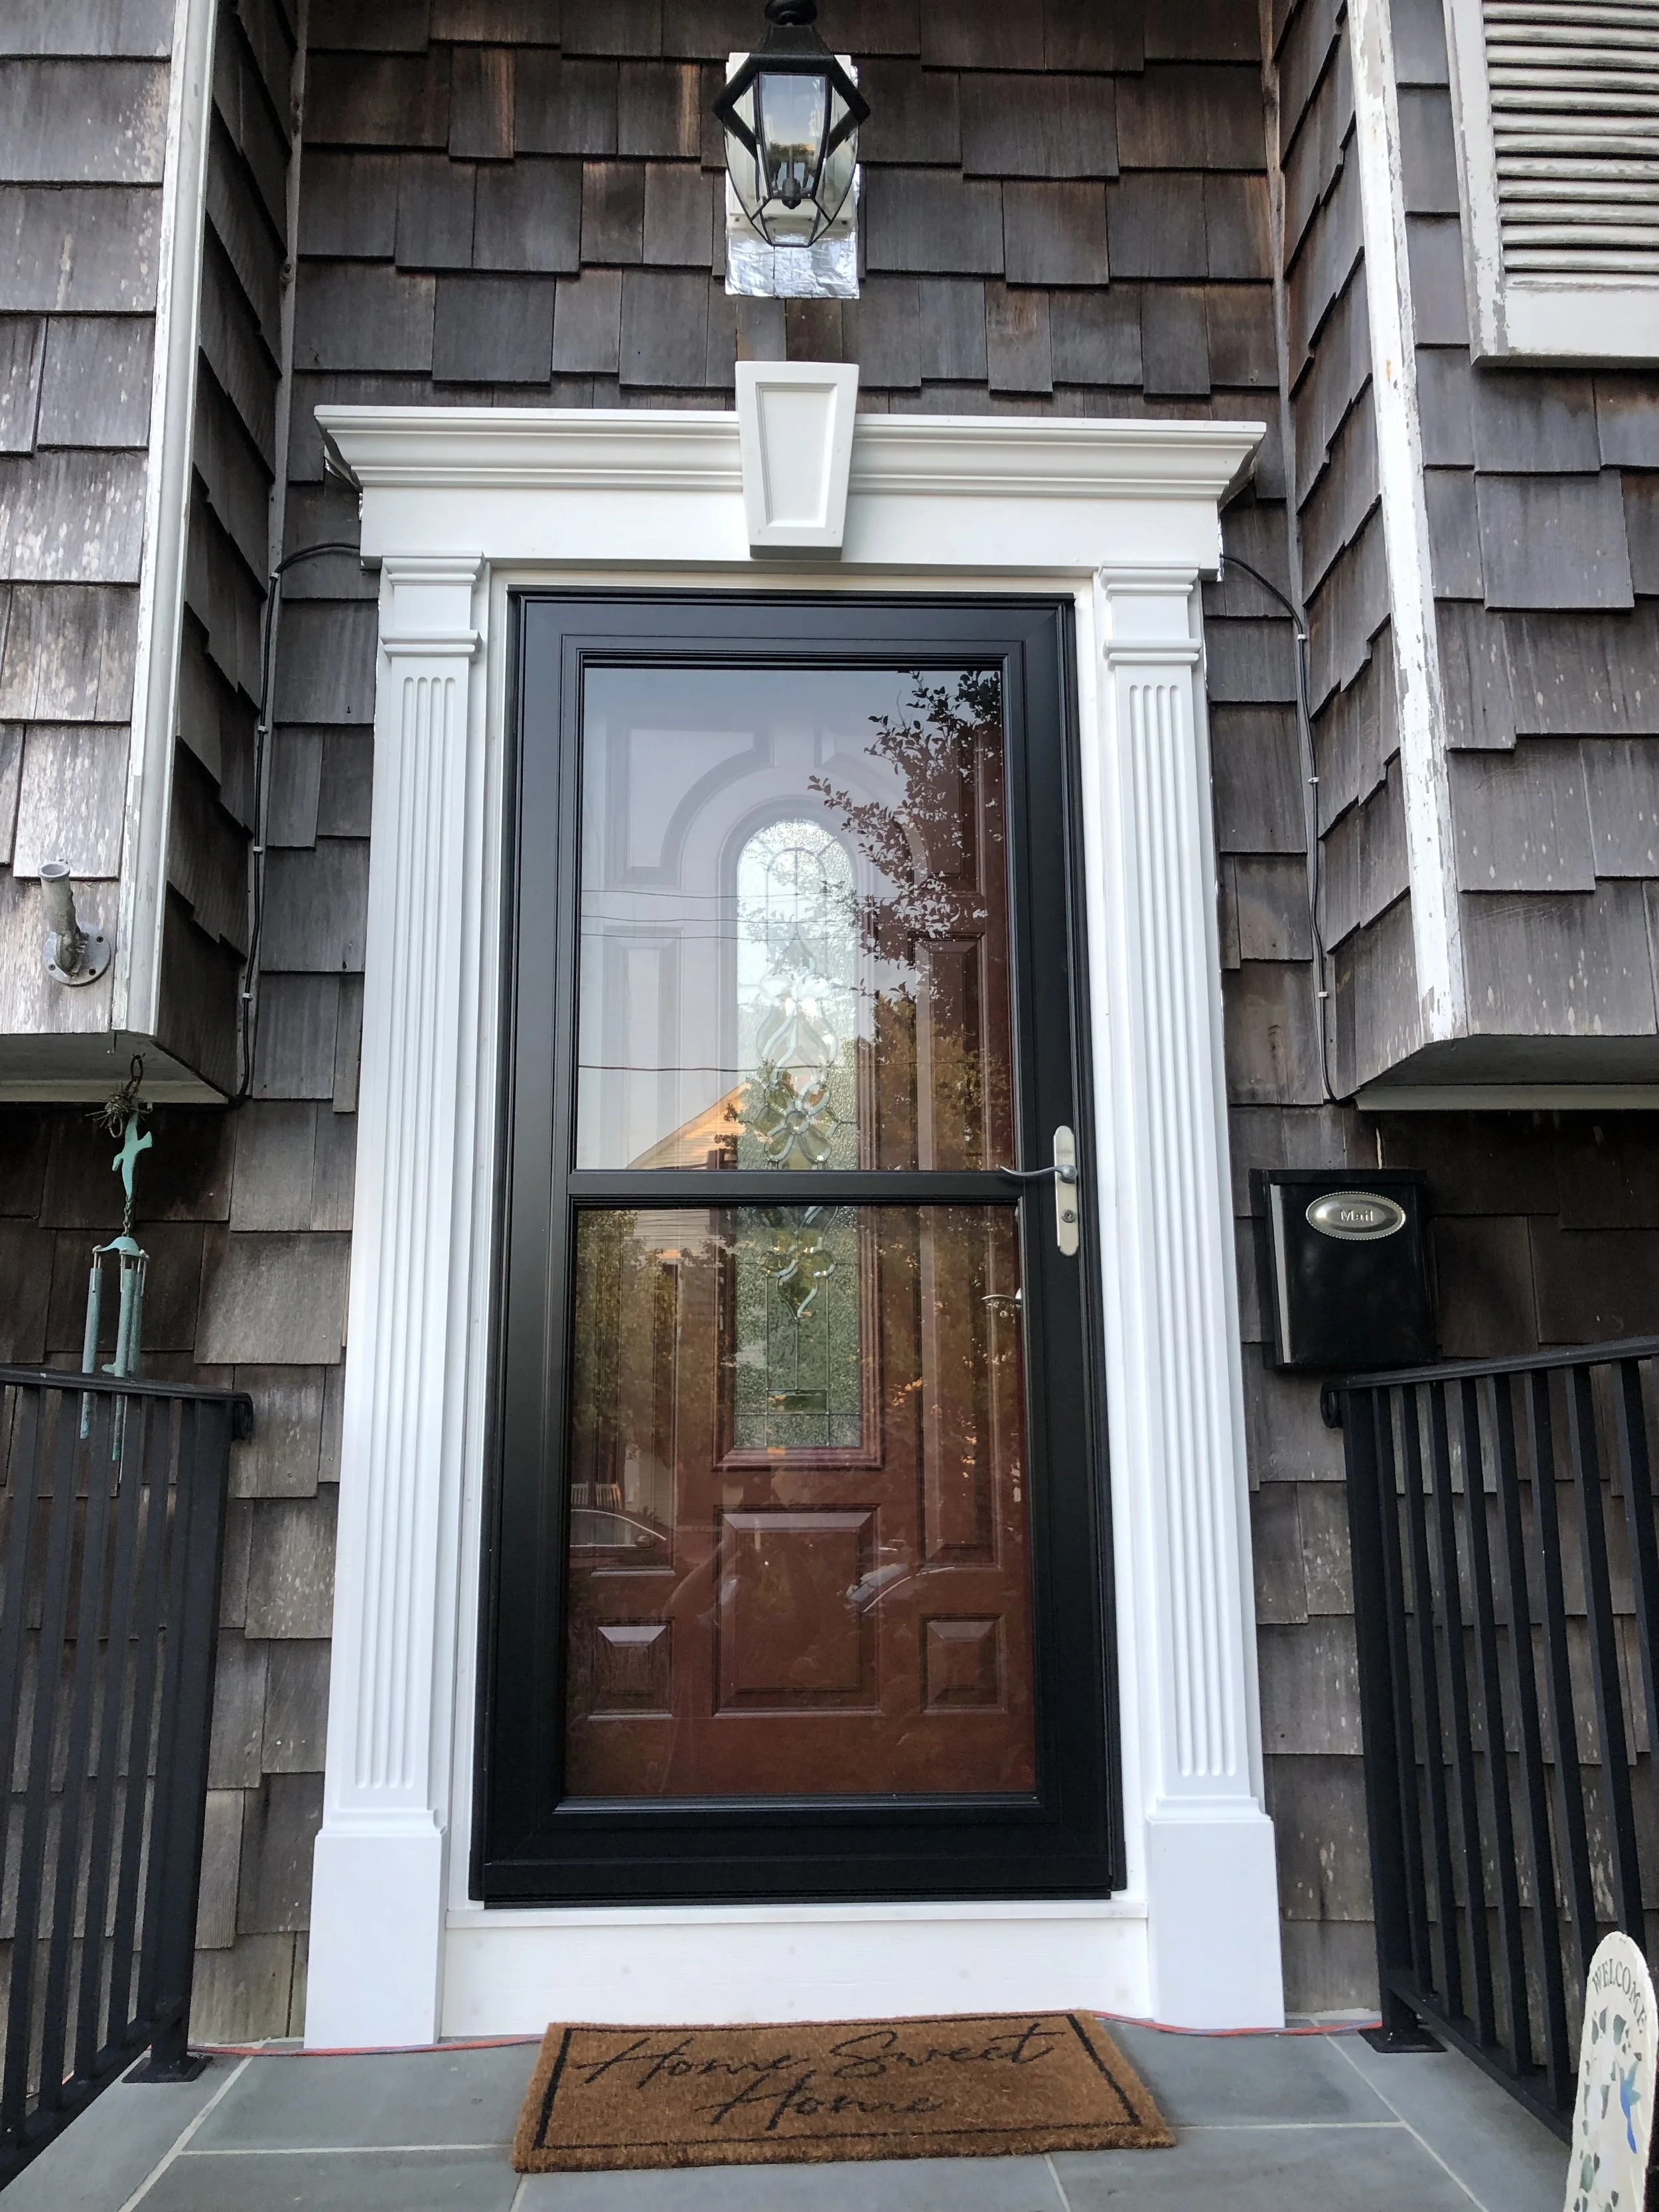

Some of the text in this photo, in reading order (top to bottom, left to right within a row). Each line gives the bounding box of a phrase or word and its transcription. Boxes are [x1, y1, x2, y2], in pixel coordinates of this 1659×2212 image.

[1340, 1209, 1374, 1222] Mail
[1592, 1958, 1647, 2028] WELCOME
[569, 2022, 1066, 2089] Home Sweet
[694, 2069, 946, 2132] Home
